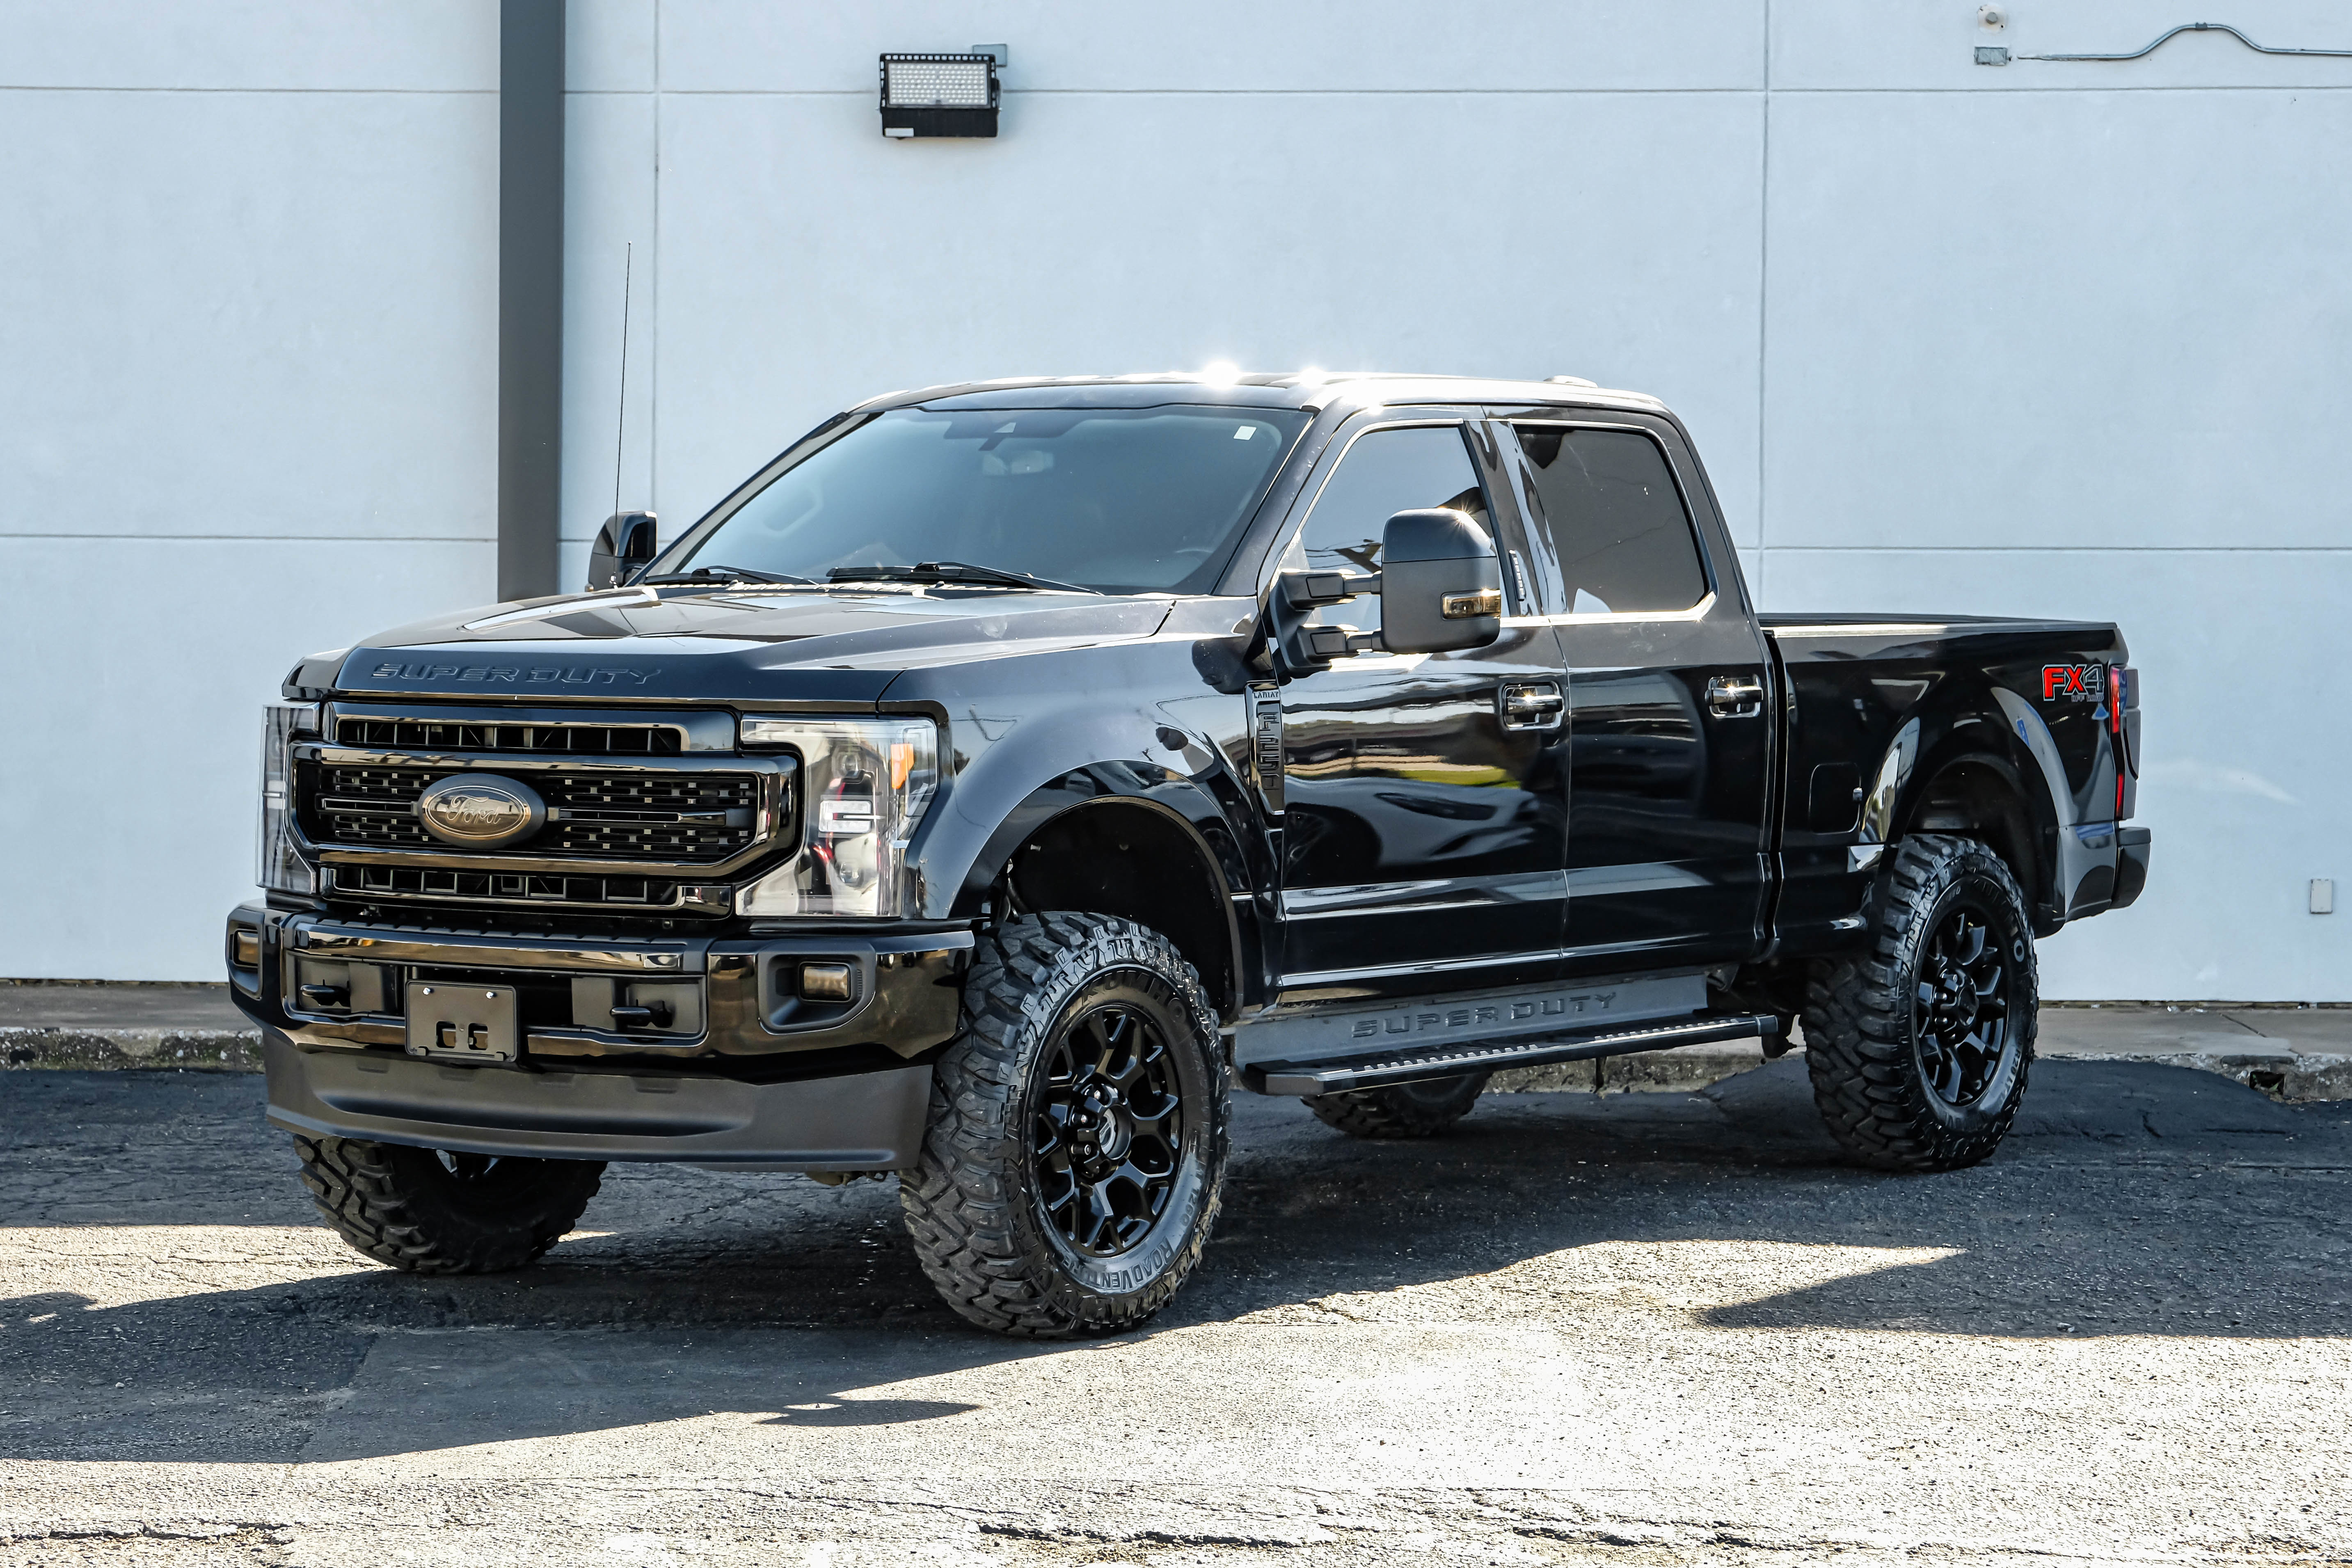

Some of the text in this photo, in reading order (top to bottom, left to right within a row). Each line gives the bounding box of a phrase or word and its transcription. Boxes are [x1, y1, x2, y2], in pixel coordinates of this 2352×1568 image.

[371, 663, 661, 684] SUPER DUTY
[2041, 664, 2105, 701] FX4
[446, 794, 501, 824] Ford
[1081, 970, 1186, 1024] KUMHO
[1351, 991, 1616, 1038] SUPER DUTY
